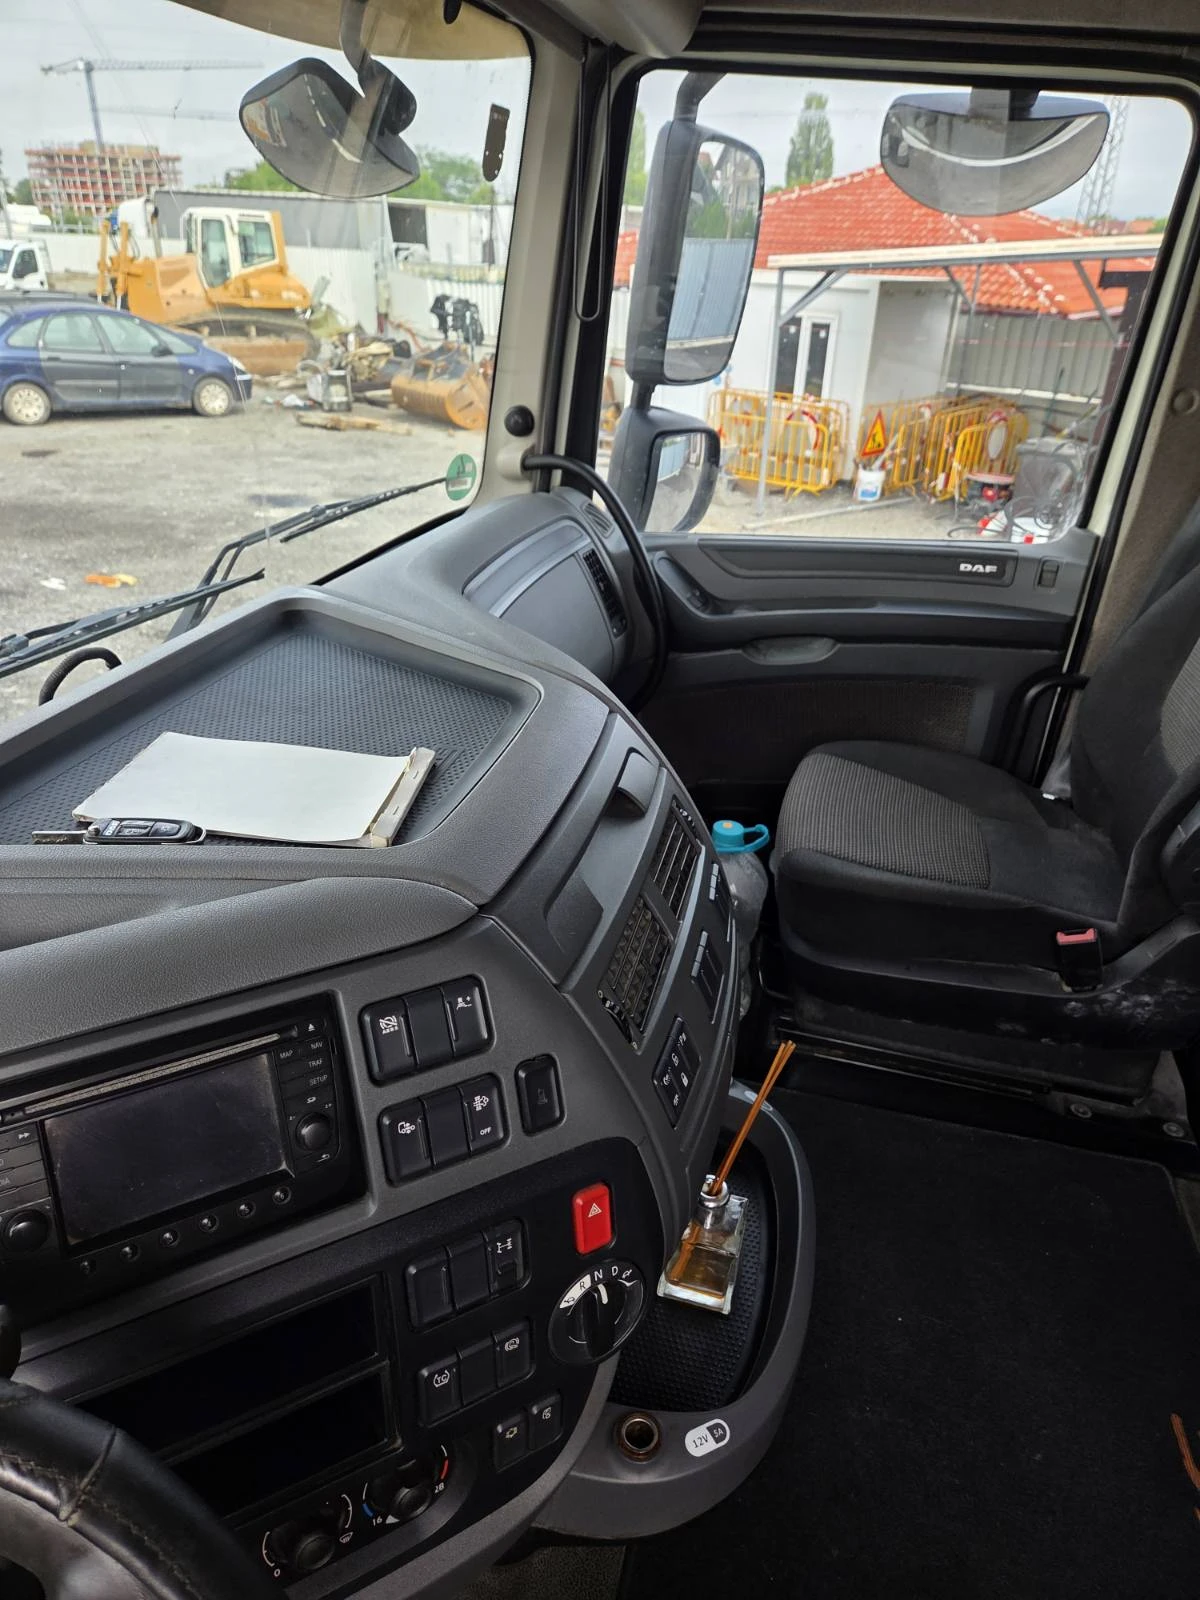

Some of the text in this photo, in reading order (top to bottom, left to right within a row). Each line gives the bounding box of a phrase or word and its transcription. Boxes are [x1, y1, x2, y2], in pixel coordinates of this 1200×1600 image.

[959, 563, 998, 573] DAF
[310, 1041, 324, 1050] NAV
[279, 1049, 294, 1060] MAP
[309, 1074, 328, 1087] SETUP
[479, 1126, 492, 1136] OFF
[593, 1269, 604, 1282] N
[611, 1265, 619, 1277] D
[578, 1280, 587, 1291] R
[436, 1373, 447, 1384] TC
[692, 1428, 724, 1450] 12V 5A
[371, 1516, 383, 1527] 16
[273, 1567, 282, 1577] 0
